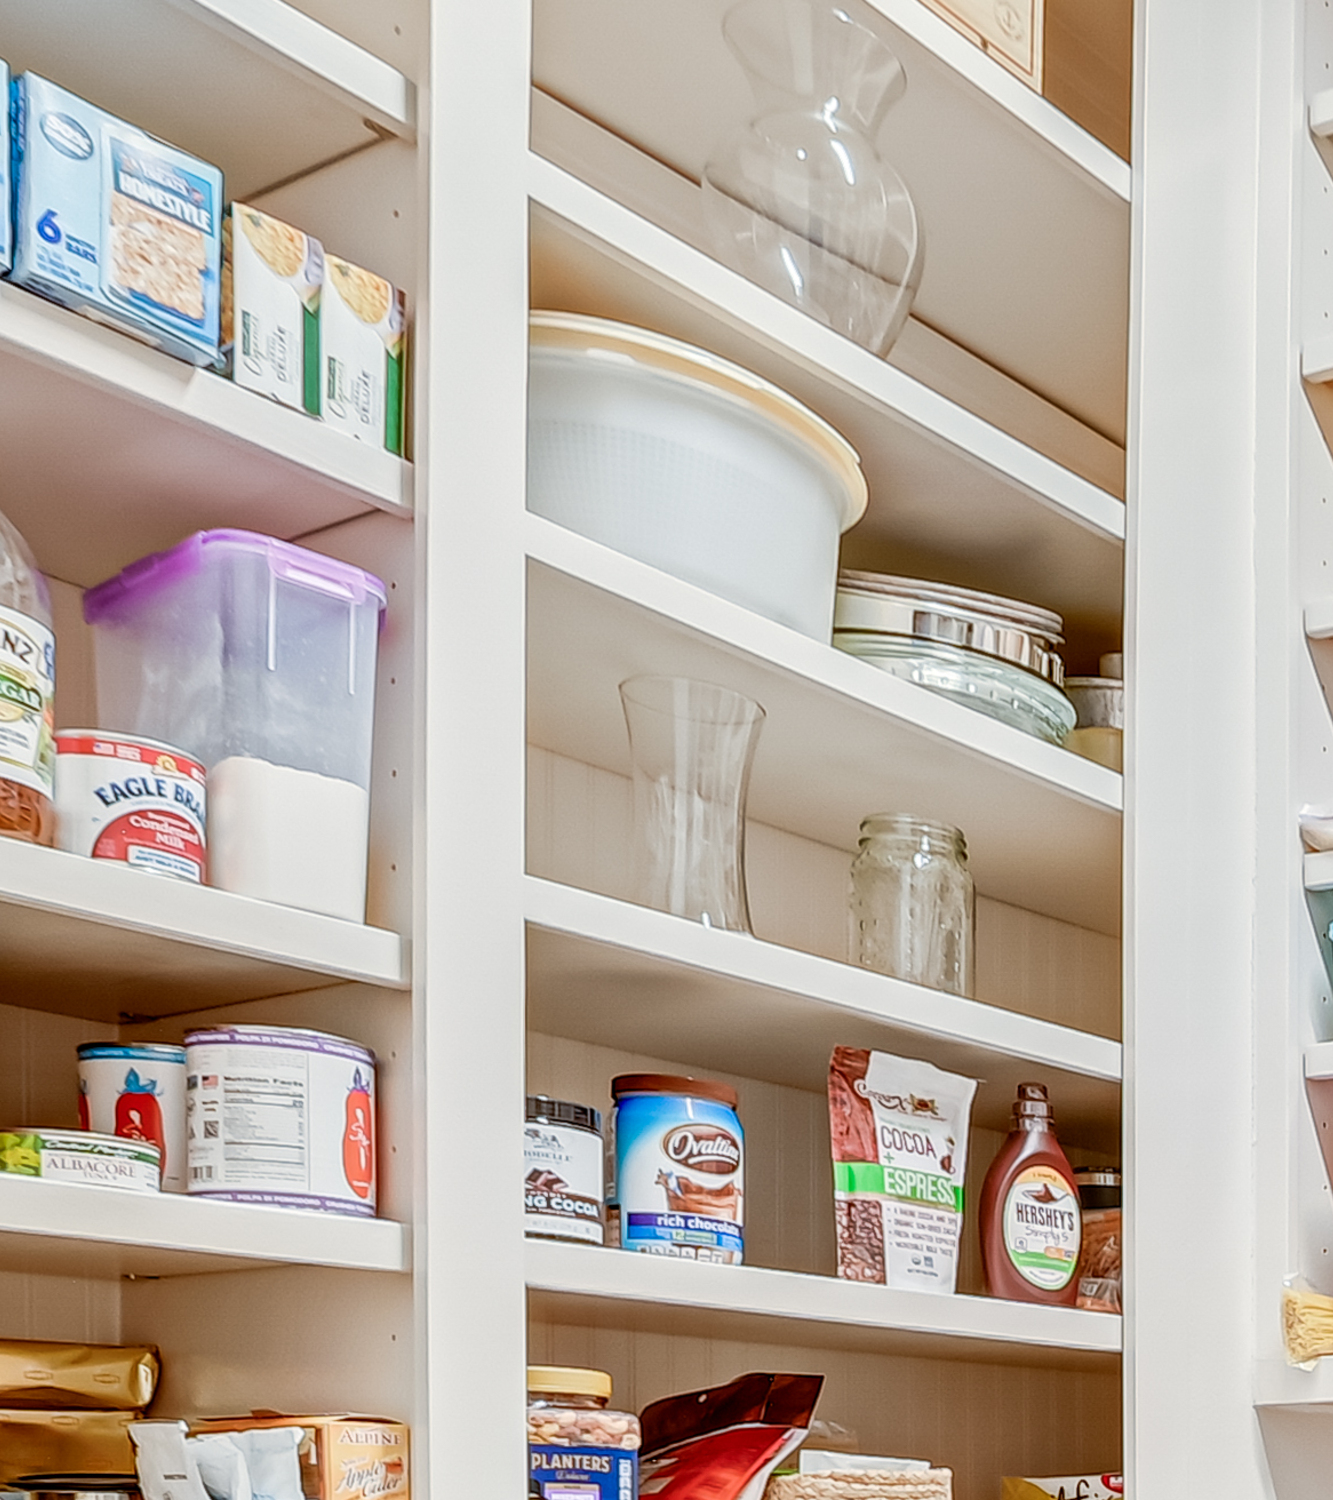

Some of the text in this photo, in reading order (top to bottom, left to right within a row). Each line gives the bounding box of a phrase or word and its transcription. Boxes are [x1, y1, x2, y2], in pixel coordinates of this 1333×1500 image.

[36, 208, 62, 244] 6
[93, 776, 168, 808] EAGLE
[667, 1130, 739, 1161] Ovaltine
[880, 1124, 937, 1160] COCOA
[46, 1155, 136, 1179] ALBACORE
[884, 1167, 957, 1208] ESPRESS
[550, 1198, 599, 1218] COCOA
[656, 1214, 685, 1229] rich
[1015, 1202, 1074, 1232] HERSHEY'S
[339, 1427, 402, 1446] ALPINE
[336, 1459, 383, 1493] Apple
[530, 1452, 611, 1474] PLANTERS
